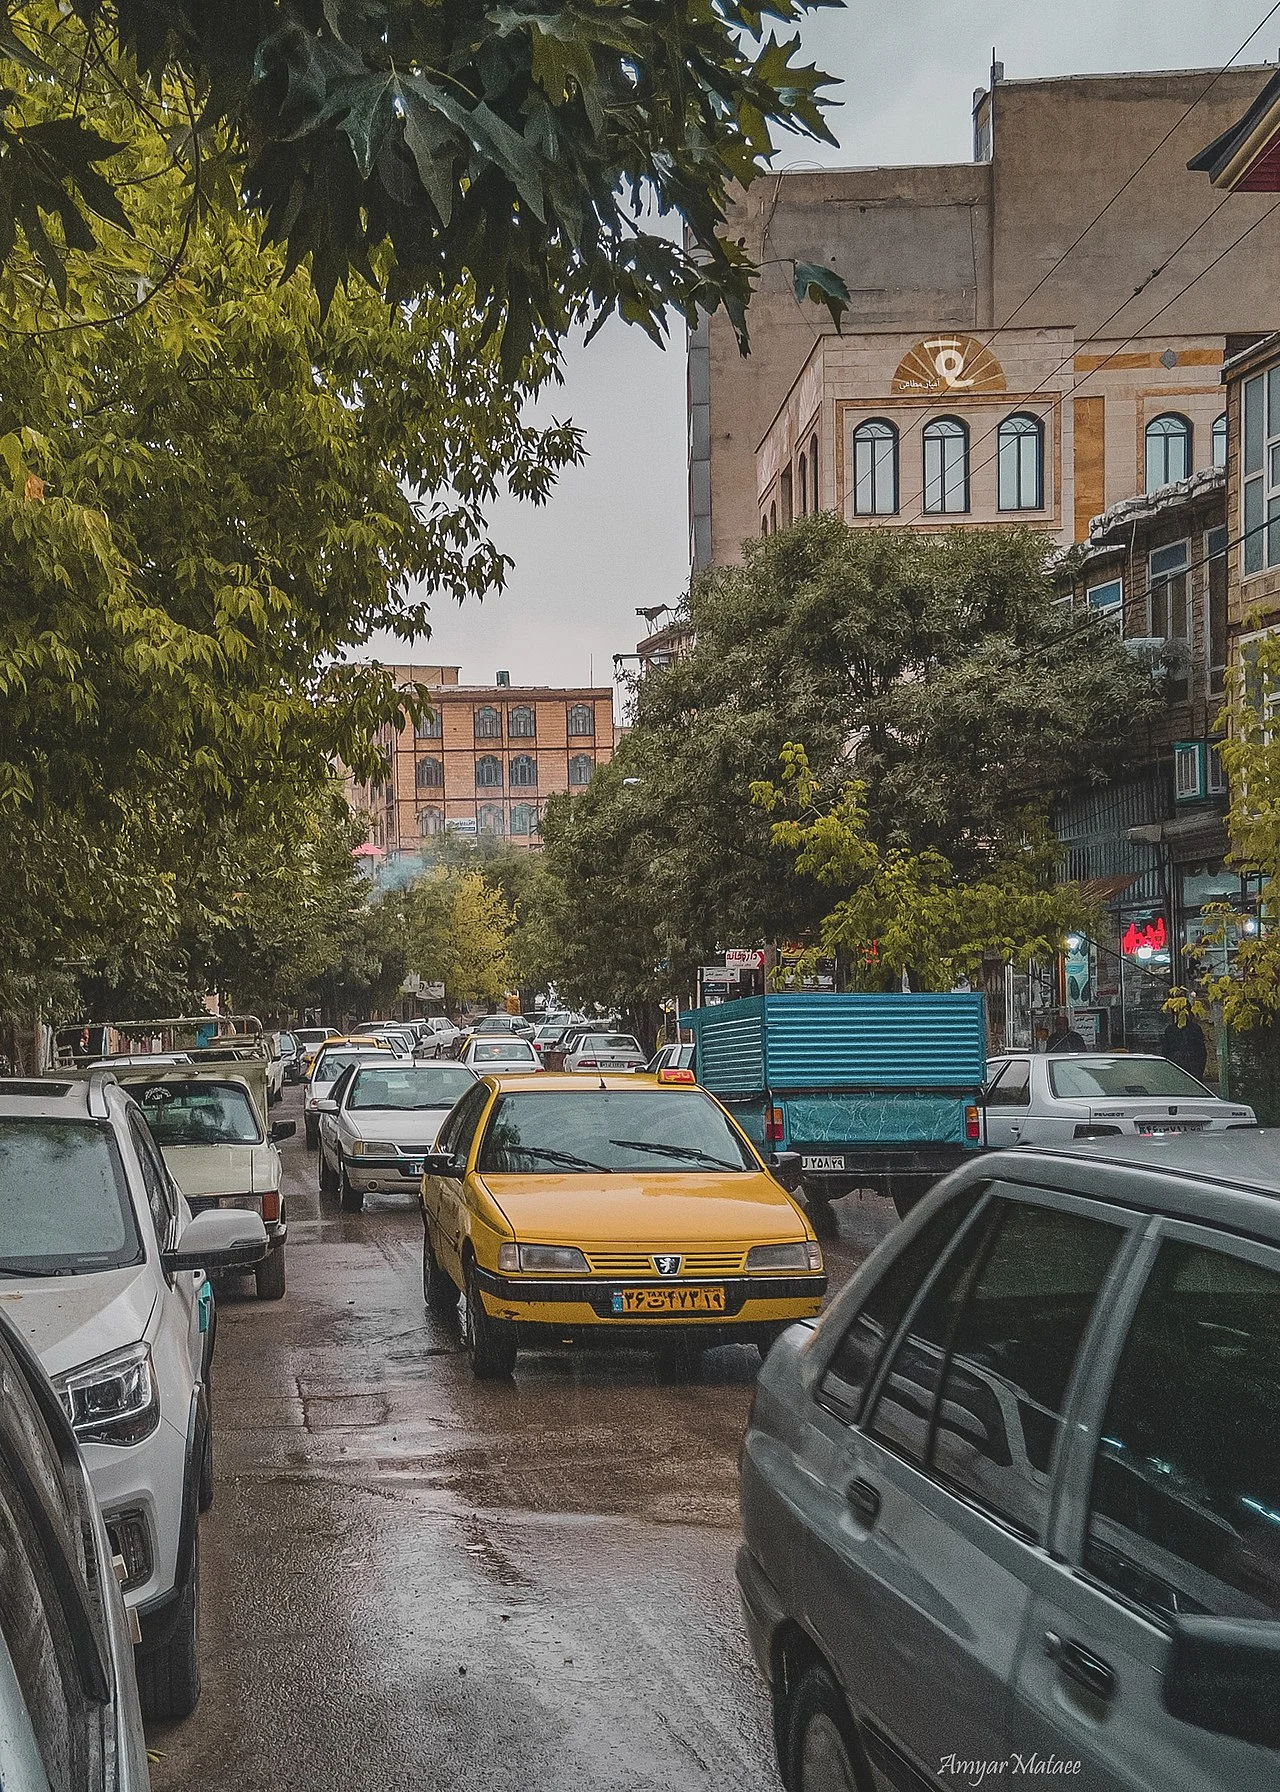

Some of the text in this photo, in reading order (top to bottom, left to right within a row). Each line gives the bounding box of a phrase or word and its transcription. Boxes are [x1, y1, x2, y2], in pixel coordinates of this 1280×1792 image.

[727, 951, 758, 962] داروخانه
[811, 1157, 830, 1169] ۲۵۸
[832, 1159, 844, 1169] ۲۹
[625, 1291, 645, 1309] ۳۶
[704, 1293, 722, 1308] ۱۹
